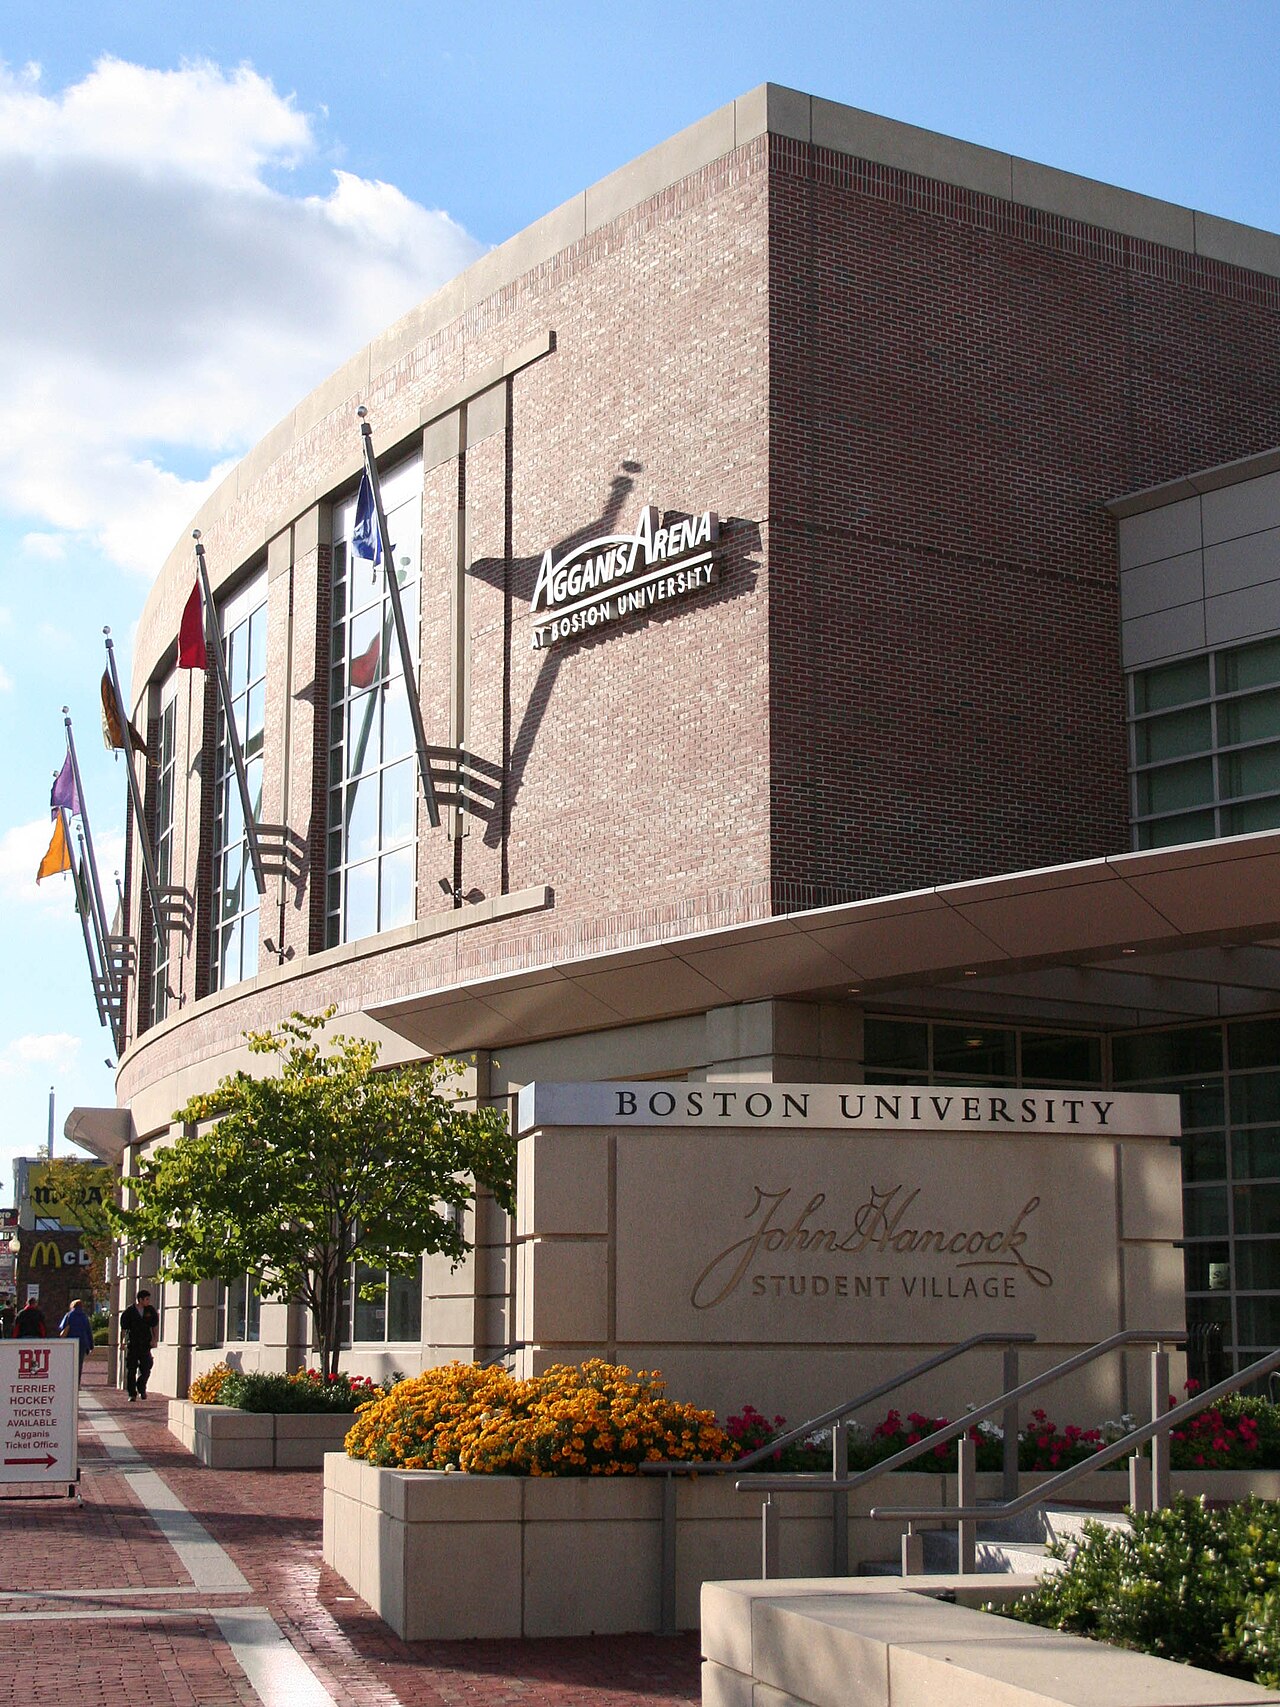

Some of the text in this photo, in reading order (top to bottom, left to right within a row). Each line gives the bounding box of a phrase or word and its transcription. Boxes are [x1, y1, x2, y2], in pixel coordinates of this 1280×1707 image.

[530, 504, 718, 613] AGGANIS ARENA
[531, 563, 714, 649] AT BOSTON UNIVERSITY
[615, 1091, 1115, 1126] BOSTON UNIVERSITY
[691, 1184, 1053, 1309] John Hancock
[752, 1275, 1016, 1299] STUDENT VILLAGE
[10, 1384, 56, 1393] TERRIER
[10, 1396, 55, 1405] HOCKEY
[13, 1409, 52, 1417] TICKETS
[7, 1418, 57, 1427] AVAILABLE
[14, 1430, 50, 1440] Agganis
[5, 1441, 59, 1449] Ticket Office
